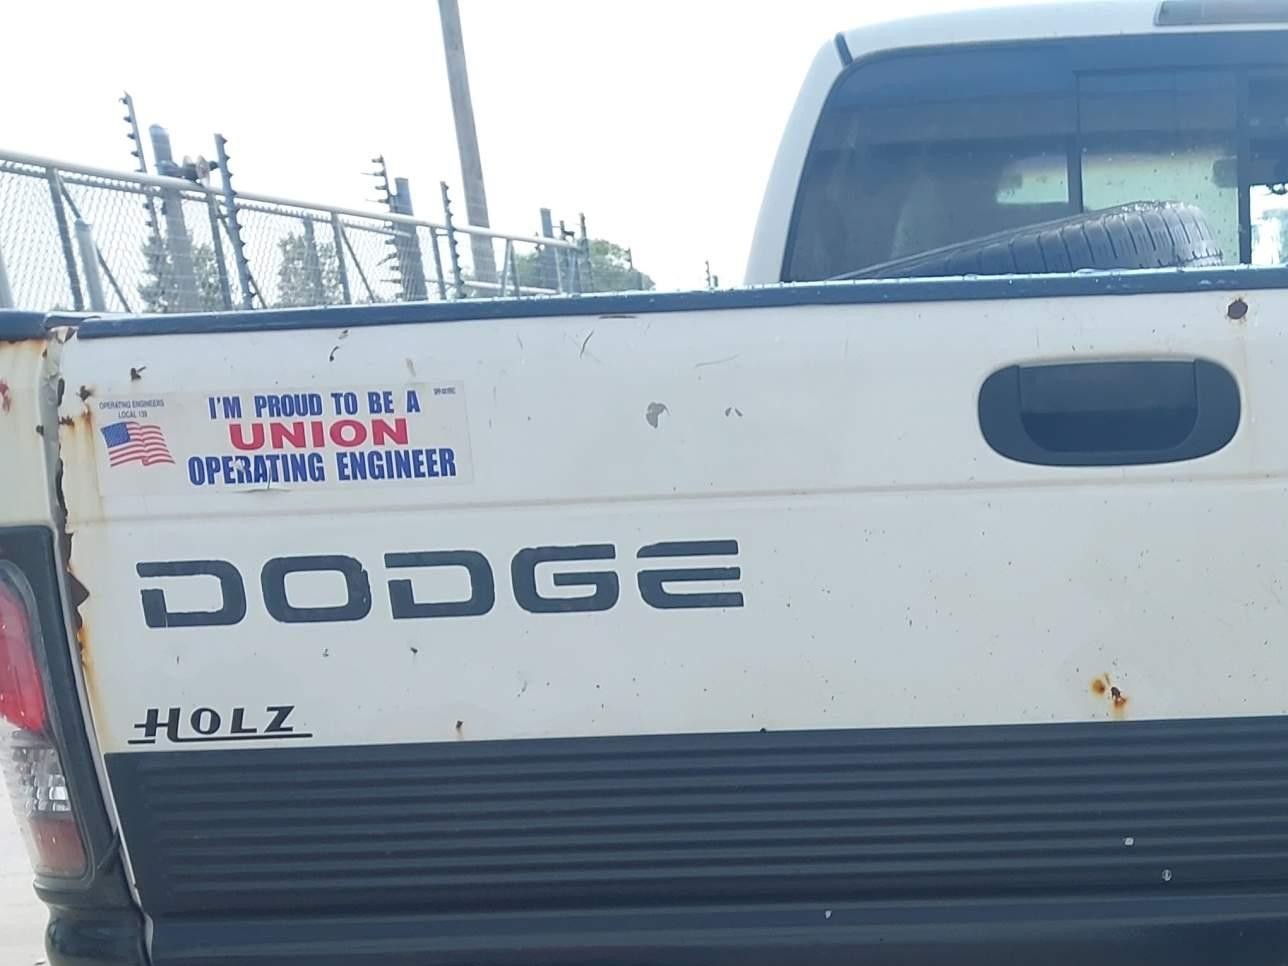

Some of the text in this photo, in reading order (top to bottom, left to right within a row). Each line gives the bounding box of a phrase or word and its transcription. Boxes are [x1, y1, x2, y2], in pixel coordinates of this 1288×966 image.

[118, 410, 137, 418] LOCAL
[208, 390, 421, 419] I'M PROUD TO BE A
[229, 418, 409, 451] UNION
[188, 448, 456, 486] OPERATING ENGINEER
[135, 539, 745, 629] DODGE
[132, 705, 298, 743] HOLZ
